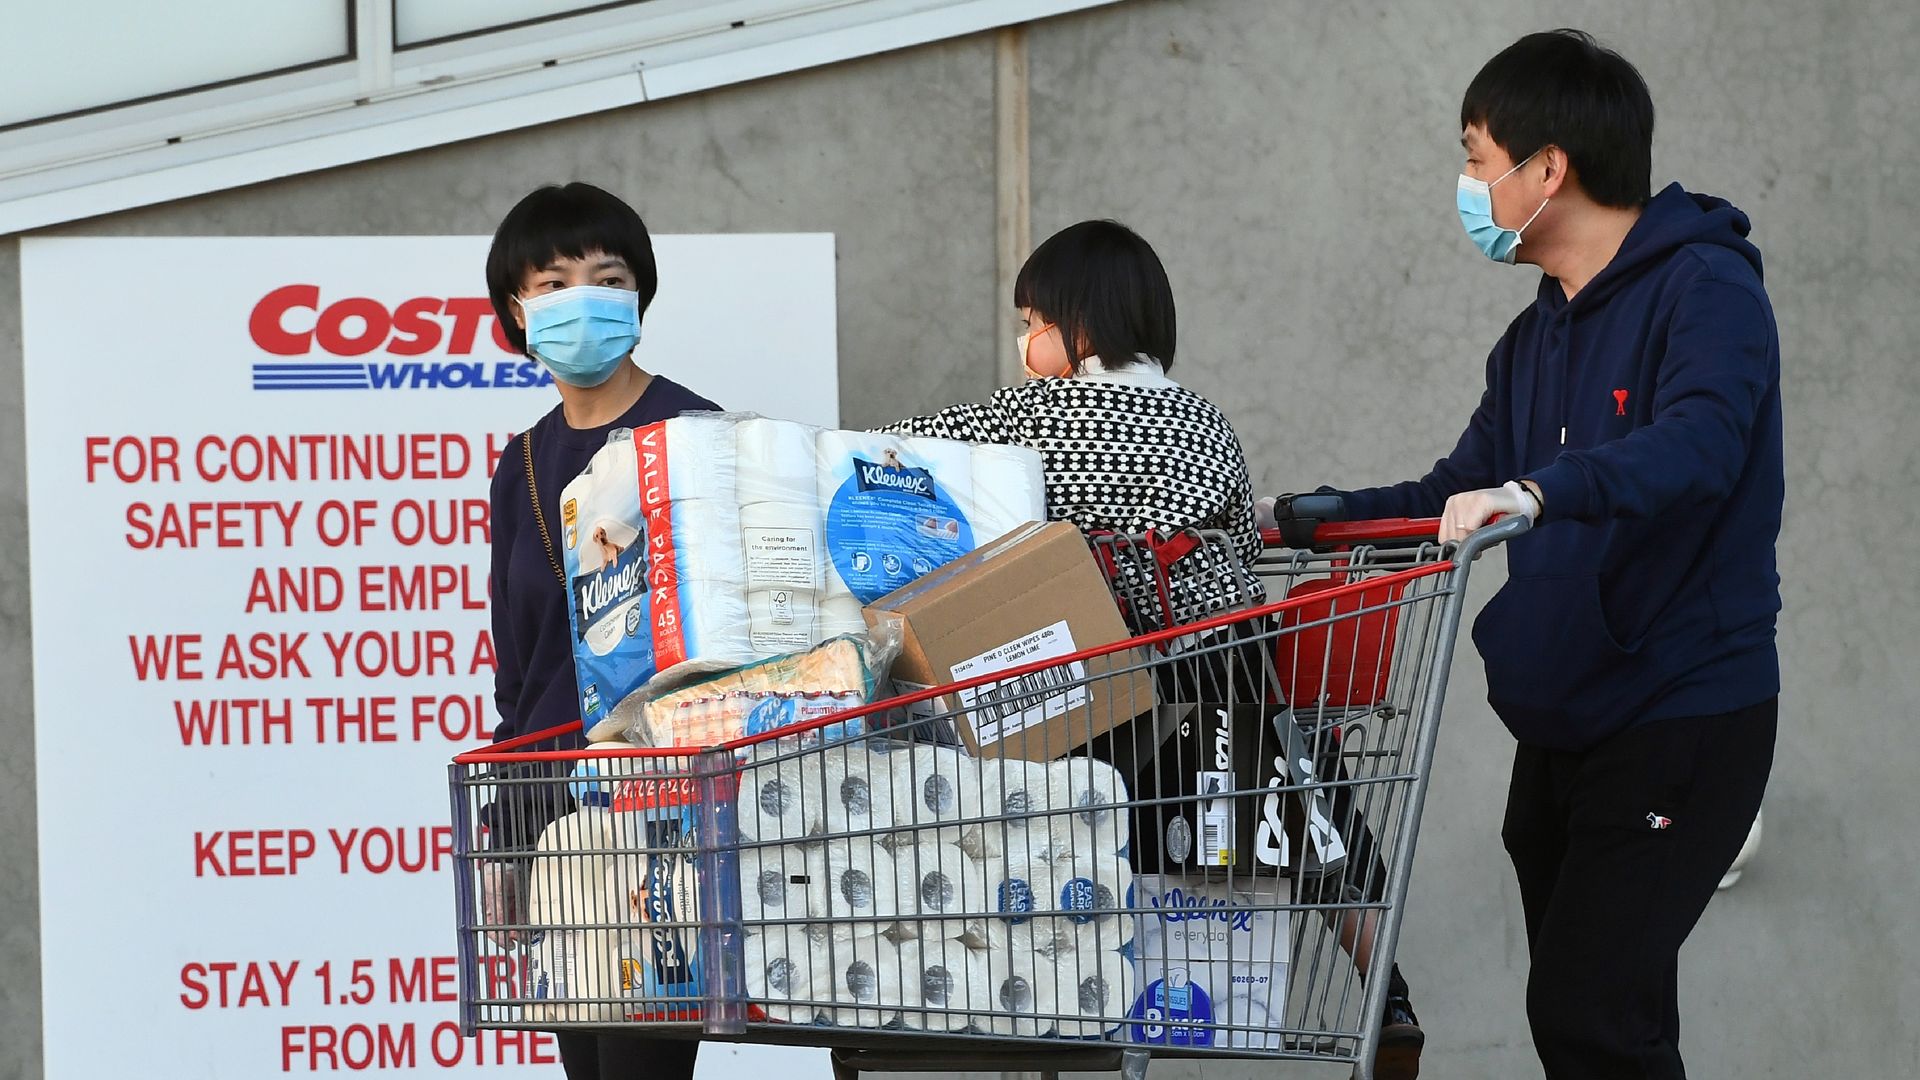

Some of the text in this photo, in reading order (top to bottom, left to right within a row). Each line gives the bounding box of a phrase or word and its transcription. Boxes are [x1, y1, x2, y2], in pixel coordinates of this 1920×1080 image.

[86, 436, 180, 483] FOR
[195, 433, 472, 483] CONTINUED
[862, 465, 929, 494] Kleenex
[126, 498, 492, 550] SAFETY OF OUR
[641, 430, 669, 606] VALUE PACK
[245, 564, 493, 613] AND EMPL
[581, 556, 642, 621] Kleenex
[658, 609, 676, 628] 45
[129, 634, 203, 681] WE
[217, 632, 310, 680] ASK
[324, 630, 455, 678] YOUR
[983, 653, 998, 664] PINE
[1003, 643, 1022, 656] CLEEN
[1021, 634, 1041, 646] WIPES
[1005, 643, 1041, 663] LEMON LIME
[175, 698, 293, 746] WITH
[306, 696, 397, 744] THE
[195, 829, 316, 877] KEEP
[329, 826, 454, 874] YOUR
[181, 961, 299, 1010] STAY
[316, 959, 376, 1006] 1.5
[281, 1023, 417, 1072] FROM
[1142, 1007, 1164, 1039] 8
